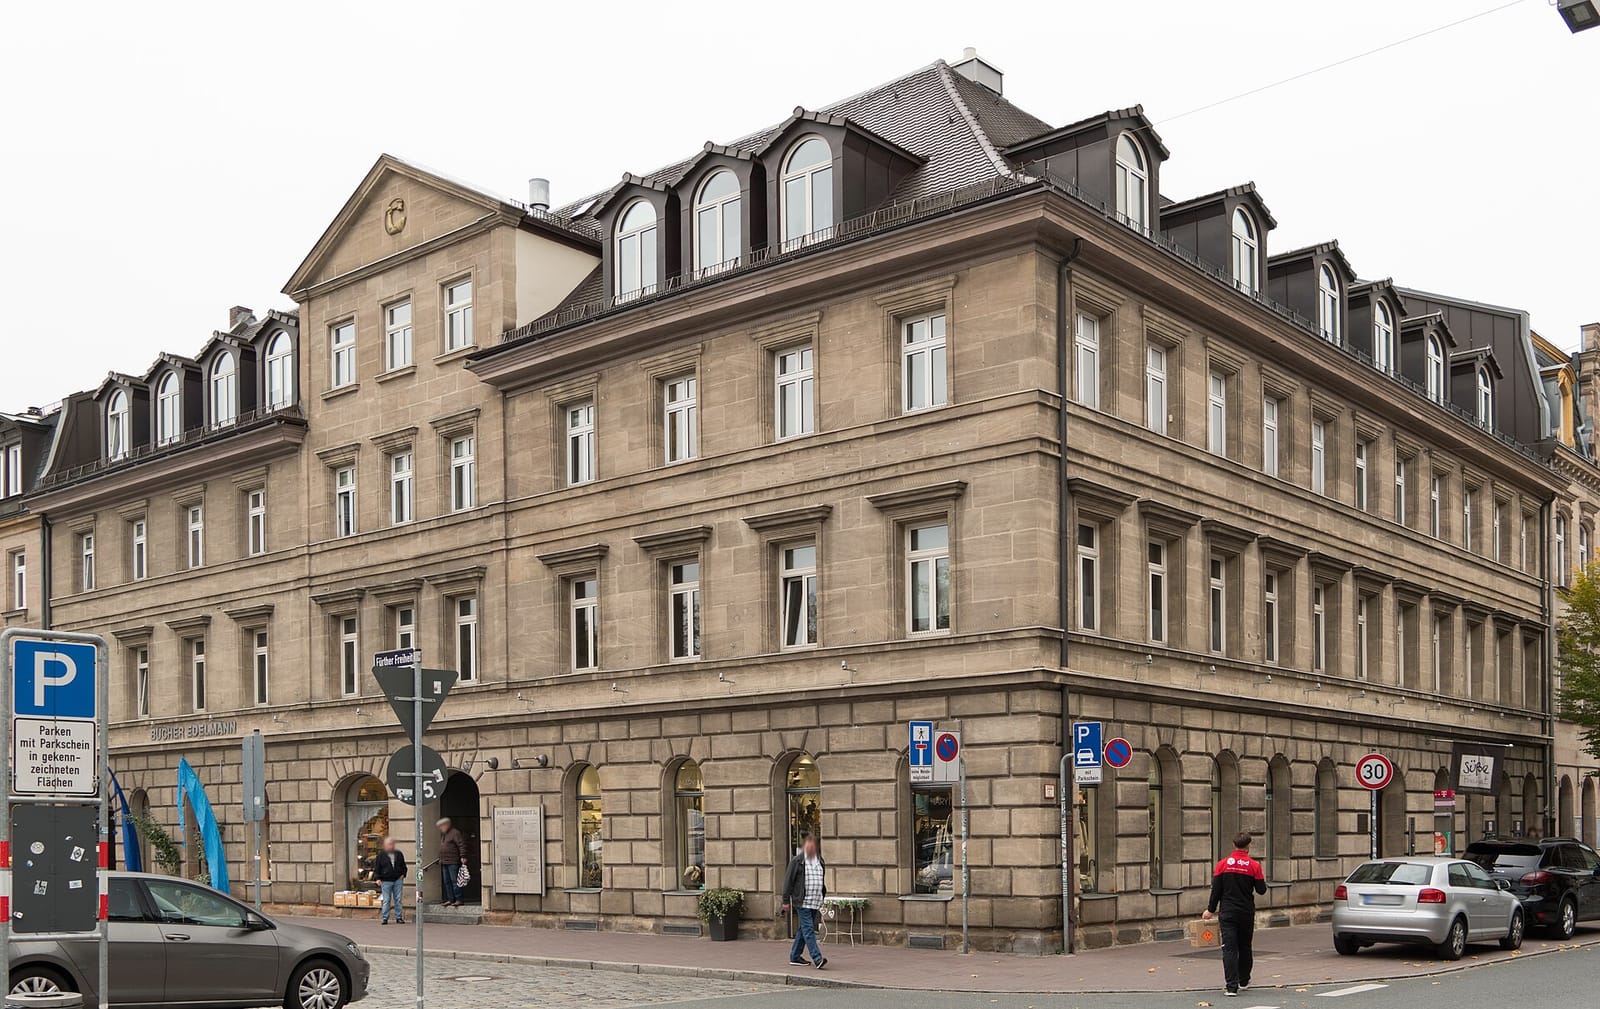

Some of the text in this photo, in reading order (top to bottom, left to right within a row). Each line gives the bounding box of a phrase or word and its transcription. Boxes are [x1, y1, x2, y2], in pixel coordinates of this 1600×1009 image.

[34, 651, 77, 707] P
[39, 725, 71, 737] Parken
[187, 720, 238, 738] EDELMANN
[1078, 726, 1090, 744] P
[20, 738, 90, 750] mit Parkschein
[29, 750, 81, 763] in gekenn-
[30, 764, 80, 775] zeichneten
[1363, 764, 1384, 780] 30
[1463, 759, 1489, 776] Süße
[37, 776, 73, 788] Flächen
